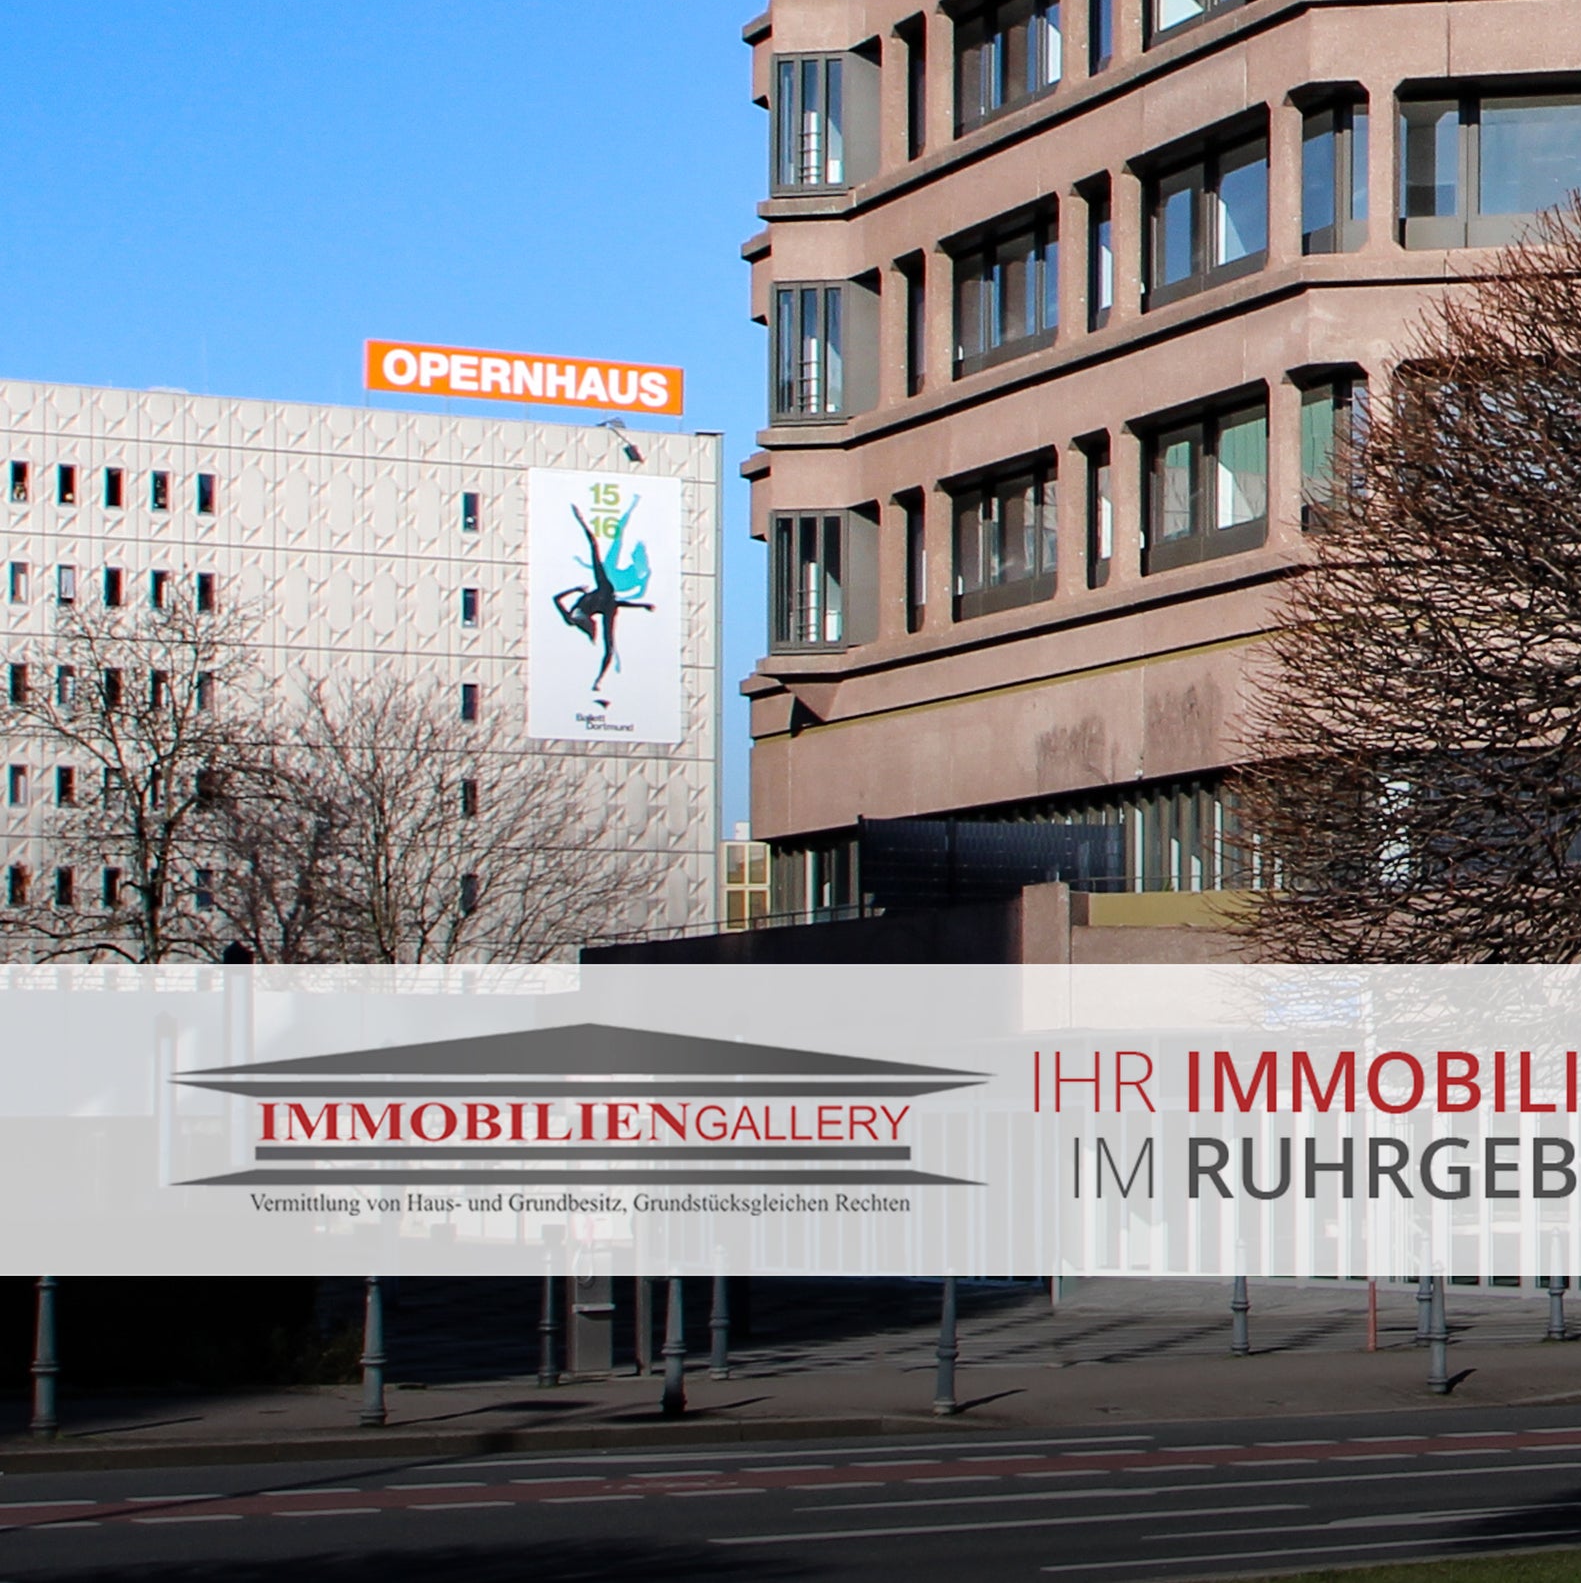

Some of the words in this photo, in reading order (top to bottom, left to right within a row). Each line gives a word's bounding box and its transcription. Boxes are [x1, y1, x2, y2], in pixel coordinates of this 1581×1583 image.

[382, 348, 668, 408] OPERNHAUS
[590, 482, 621, 506] 15
[590, 516, 621, 540] 16
[585, 721, 635, 732] Dortmund
